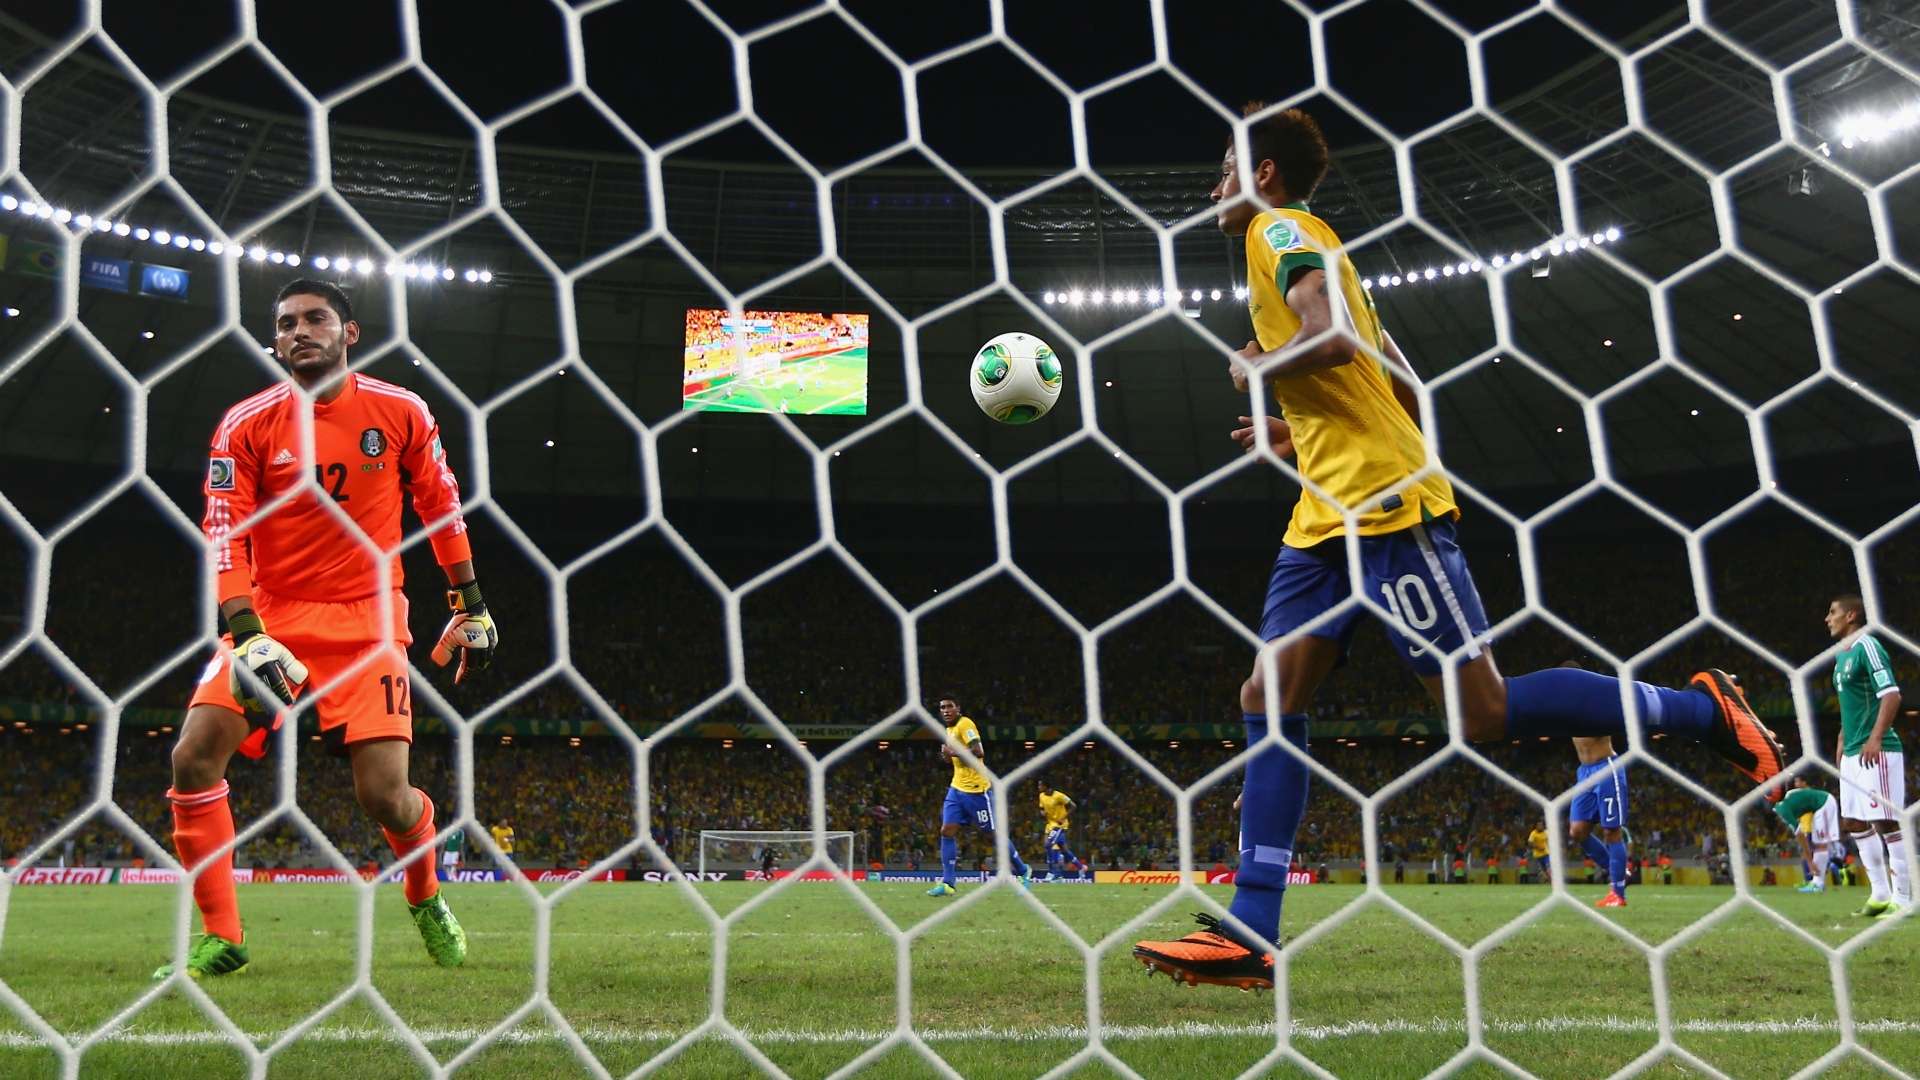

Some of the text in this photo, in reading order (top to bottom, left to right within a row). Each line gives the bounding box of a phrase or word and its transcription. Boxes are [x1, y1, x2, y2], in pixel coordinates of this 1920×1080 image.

[91, 261, 120, 277] FIFA
[1381, 574, 1437, 635] 10
[380, 675, 409, 716] 12
[1603, 798, 1613, 815] 7
[976, 809, 989, 823] 18
[19, 867, 106, 884] Castrol
[274, 872, 349, 883] McDonald
[1120, 869, 1182, 884] Garoto
